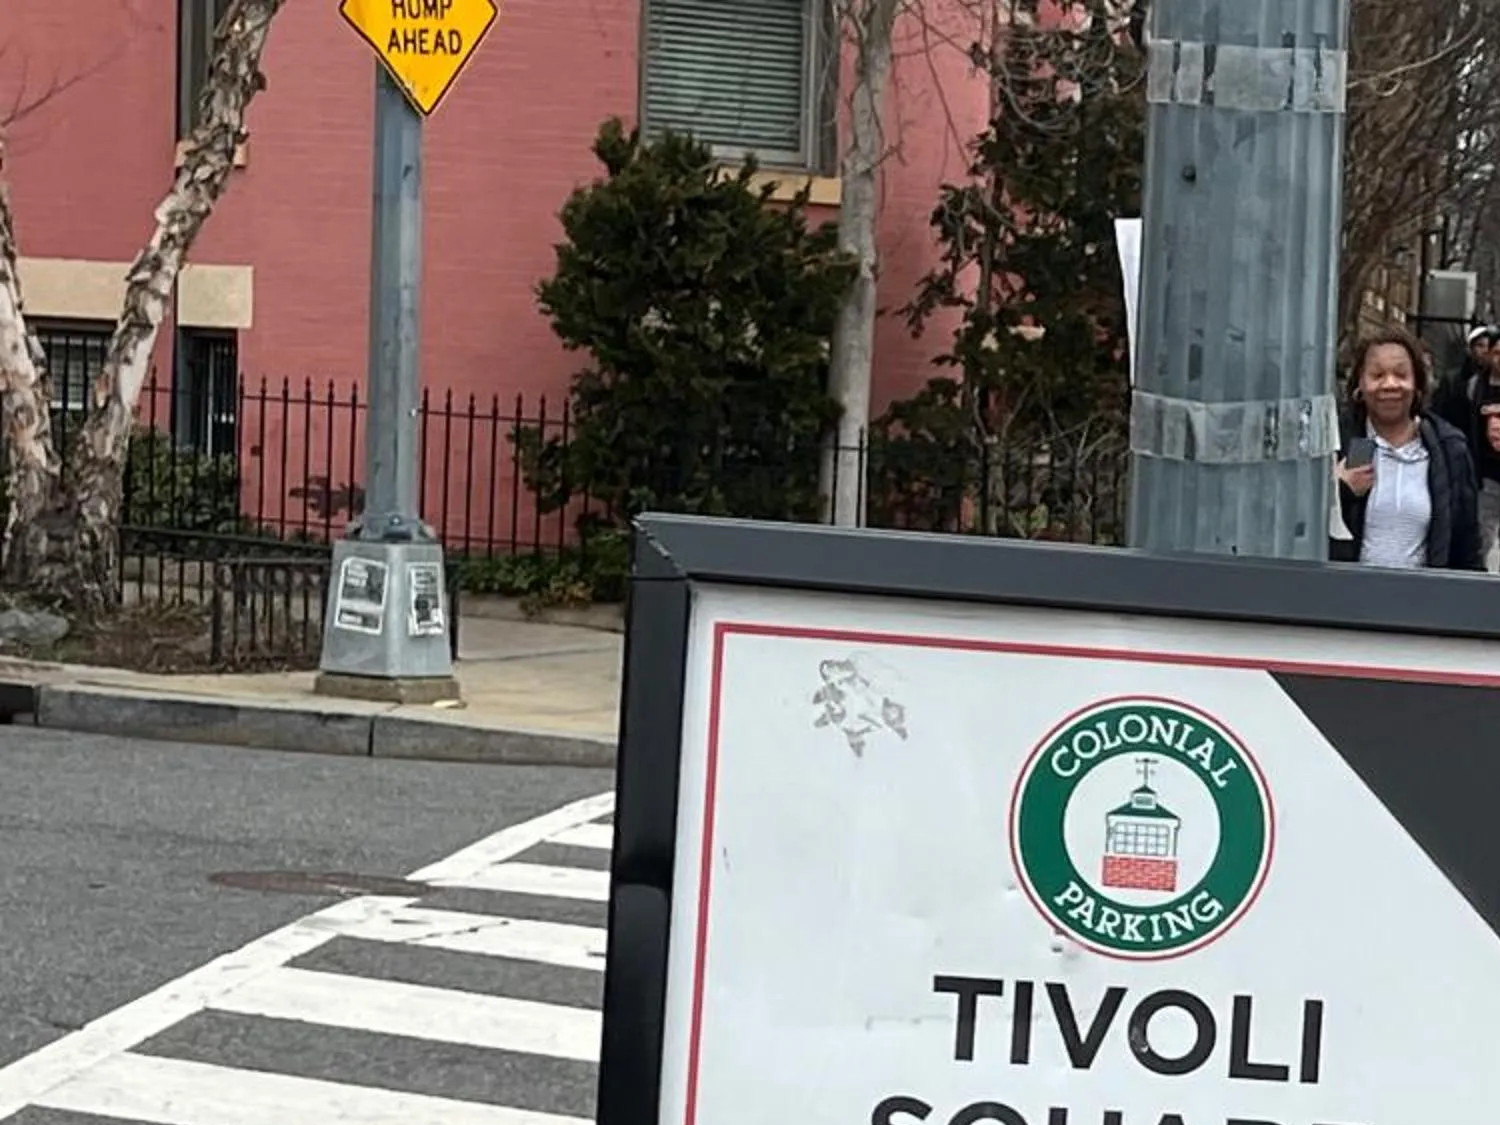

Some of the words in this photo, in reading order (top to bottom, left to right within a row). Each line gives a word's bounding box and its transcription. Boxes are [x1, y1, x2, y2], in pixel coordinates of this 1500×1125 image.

[391, 0, 452, 19] HUMP
[387, 28, 462, 54] AHEAD
[1051, 714, 1237, 787] COLONIAL
[1054, 881, 1223, 941] PARKING
[933, 974, 1324, 1084] TIVOLI
